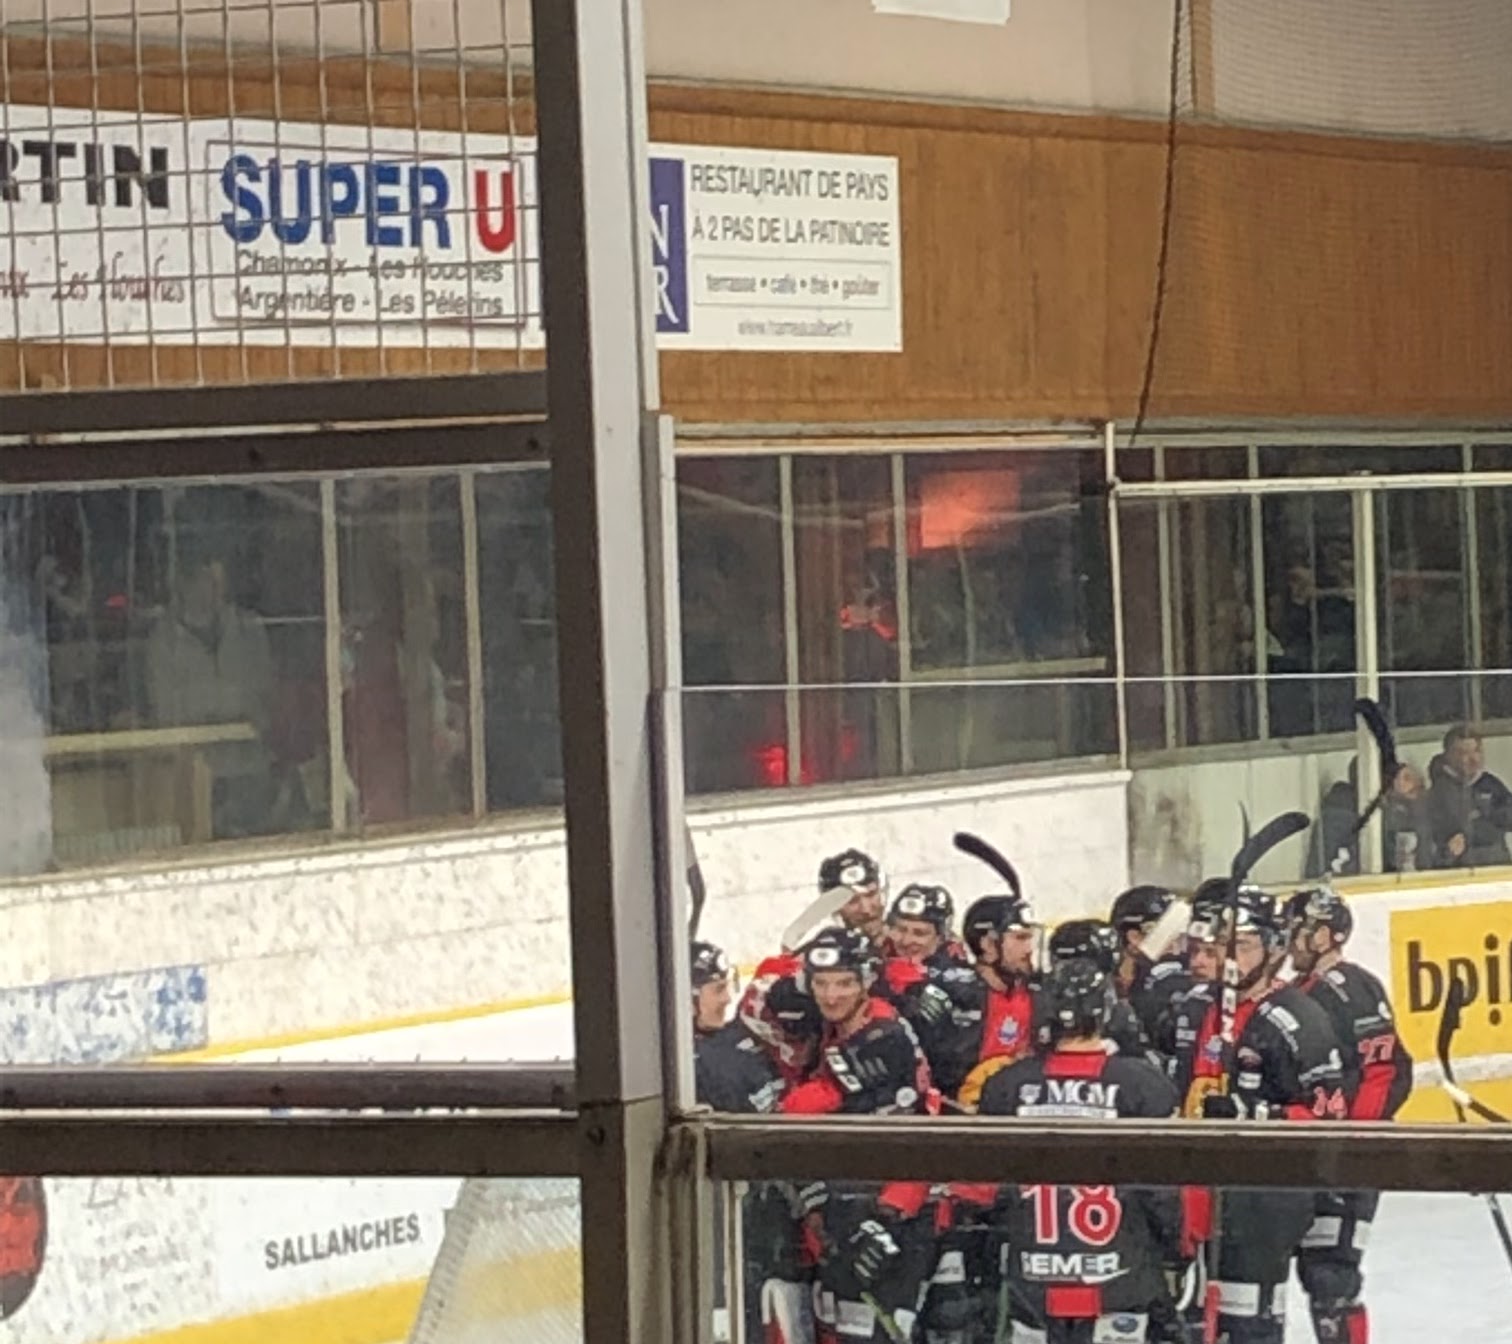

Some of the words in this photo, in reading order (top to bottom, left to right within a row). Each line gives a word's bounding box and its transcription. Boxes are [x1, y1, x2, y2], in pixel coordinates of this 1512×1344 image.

[691, 164, 813, 197] RESTAURANT
[818, 170, 843, 199] DE
[846, 172, 889, 201] PAYS
[220, 153, 450, 249] SUPER
[474, 169, 516, 254] U
[708, 215, 718, 241] 2
[722, 215, 754, 241] PAS
[759, 218, 781, 244] DE
[784, 219, 807, 244] LA
[810, 219, 891, 247] PATINOIRE
[238, 250, 348, 277] Chamonix
[1046, 1079, 1119, 1108] MGM
[1020, 1184, 1122, 1246] 18
[264, 1213, 421, 1271] SALLANCHES
